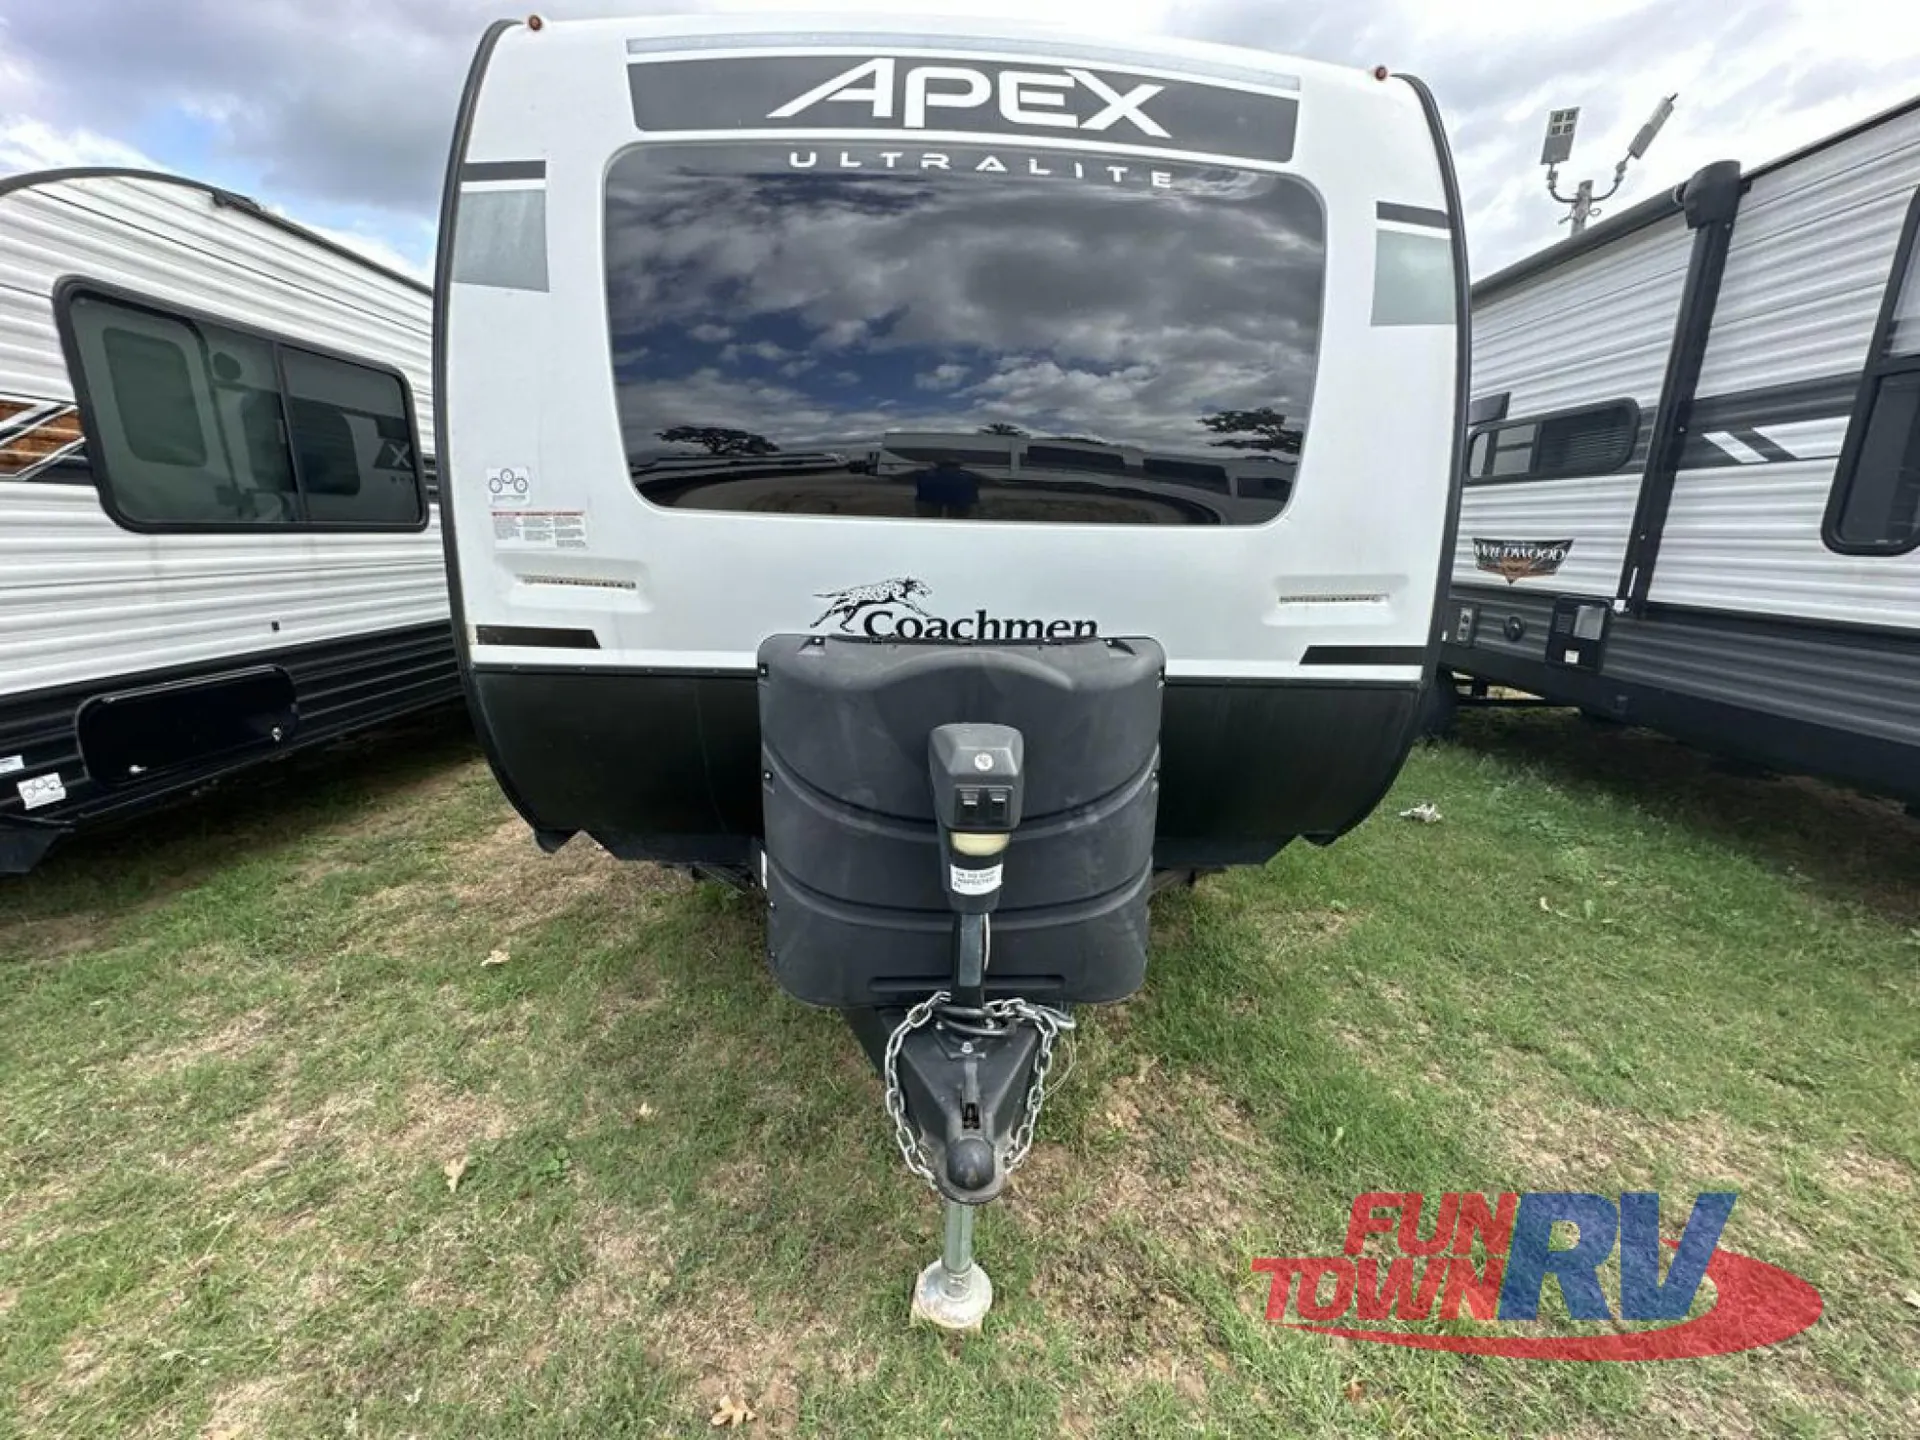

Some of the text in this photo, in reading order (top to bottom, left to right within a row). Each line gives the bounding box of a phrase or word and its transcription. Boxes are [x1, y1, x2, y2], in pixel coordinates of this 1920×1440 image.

[767, 58, 1172, 138] APEX
[789, 150, 1174, 188] ULTRALITE
[865, 610, 1098, 639] Coachmen
